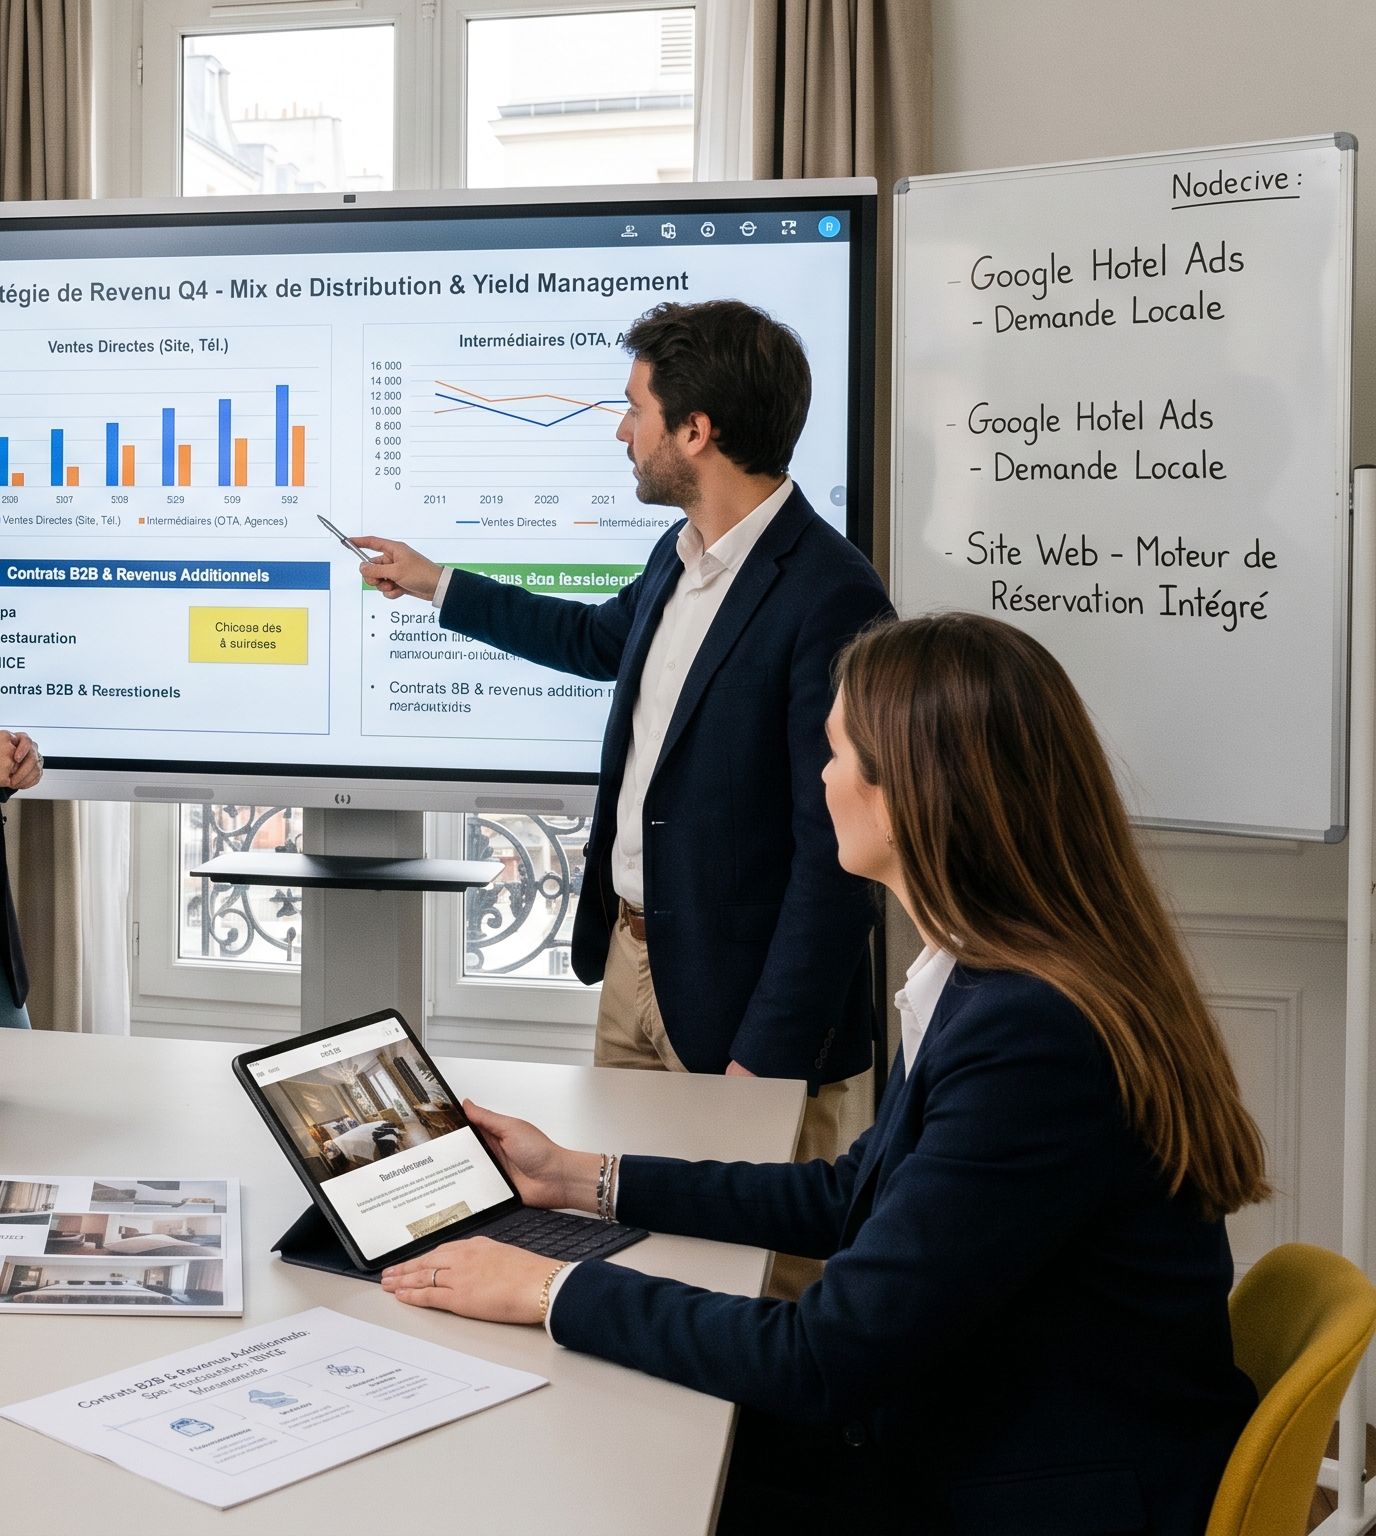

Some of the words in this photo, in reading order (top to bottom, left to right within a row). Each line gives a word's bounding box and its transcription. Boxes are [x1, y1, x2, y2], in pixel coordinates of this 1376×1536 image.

[1172, 169, 1288, 198] Nodecive
[971, 252, 1073, 300] Google
[1093, 244, 1165, 281] Hotel
[1185, 241, 1244, 274] Ads
[58, 283, 82, 302] de
[91, 283, 170, 301] Revenu
[179, 280, 208, 300] Q4
[231, 279, 267, 298] Mix
[276, 279, 301, 297] de
[311, 276, 440, 296] Distribution
[450, 275, 465, 294] &
[473, 274, 528, 293] Yield
[538, 272, 688, 297] Management
[996, 299, 1116, 333] Demande
[1133, 290, 1224, 323] Locale
[47, 340, 94, 354] Ventes
[98, 339, 155, 353] Directes
[160, 339, 193, 355] (Site,
[199, 338, 228, 354] Tél.)
[460, 333, 564, 347] Intermédiaires
[571, 333, 610, 349] (OTA,
[370, 361, 382, 371] 16
[384, 361, 402, 371] 000
[370, 376, 382, 386] 14
[384, 376, 402, 386] 000
[370, 391, 382, 401] 12
[375, 421, 382, 431] 8
[383, 421, 402, 431] 600
[969, 402, 1060, 445] Google
[1078, 400, 1142, 431] Hotel
[1160, 399, 1213, 429] Ads
[374, 436, 382, 446] 6
[383, 436, 402, 446] 000
[374, 451, 381, 461] 4
[374, 466, 381, 476] 2
[383, 466, 402, 476] 500
[995, 450, 1117, 481] Demande
[1136, 449, 1226, 479] Locale
[394, 481, 401, 491] 0
[281, 495, 299, 504] 592
[423, 494, 446, 505] 2011
[479, 494, 504, 505] 2019
[534, 494, 560, 505] 2020
[591, 495, 615, 505] 2021
[2, 515, 34, 525] Ventes
[35, 515, 73, 525] Directes
[75, 515, 99, 527] (Site,
[100, 515, 121, 527] Tél.)
[146, 515, 212, 526] Intermédiaires
[214, 515, 242, 528] (OTA,
[243, 516, 288, 529] Agences)
[480, 517, 515, 527] Ventes
[517, 517, 557, 527] Directes
[599, 517, 670, 528] Intermédiaires
[967, 531, 1021, 565] Site
[1037, 534, 1097, 566] Web
[1138, 536, 1229, 567] Moteur
[1244, 538, 1277, 569] de
[8, 567, 65, 580] Contrats
[69, 567, 98, 581] B2B
[101, 567, 113, 581] &
[117, 568, 176, 581] Revenus
[181, 569, 269, 582] Additionnels
[993, 580, 1143, 614] Réservation
[1159, 585, 1268, 632] Intégré
[46, 683, 74, 696] B2B
[77, 683, 88, 696] &
[390, 681, 446, 694] Contrats
[474, 682, 484, 696] &
[488, 685, 543, 697] revenus
